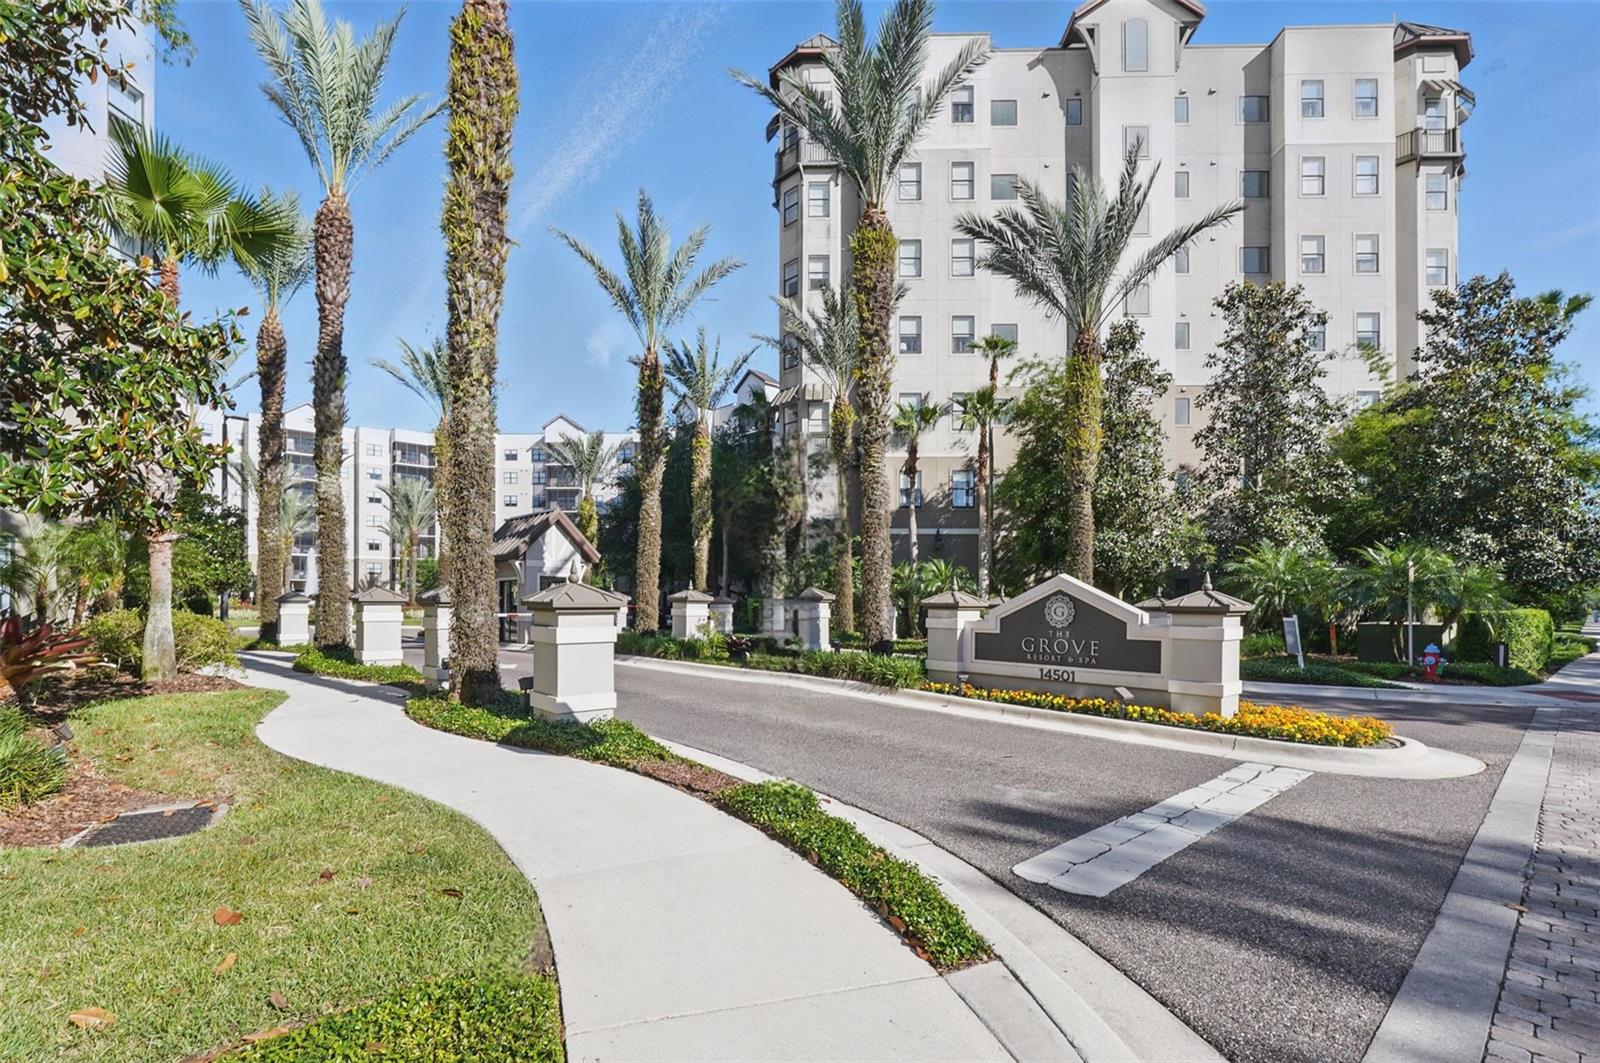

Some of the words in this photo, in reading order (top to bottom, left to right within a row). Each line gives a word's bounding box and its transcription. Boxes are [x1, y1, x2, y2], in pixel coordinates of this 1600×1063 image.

[1053, 605, 1065, 617] G
[1049, 630, 1070, 638] THE
[1021, 637, 1100, 656] GROVE
[1026, 653, 1061, 662] RESORT
[1079, 657, 1097, 665] SPA
[1039, 668, 1076, 683] 14501
